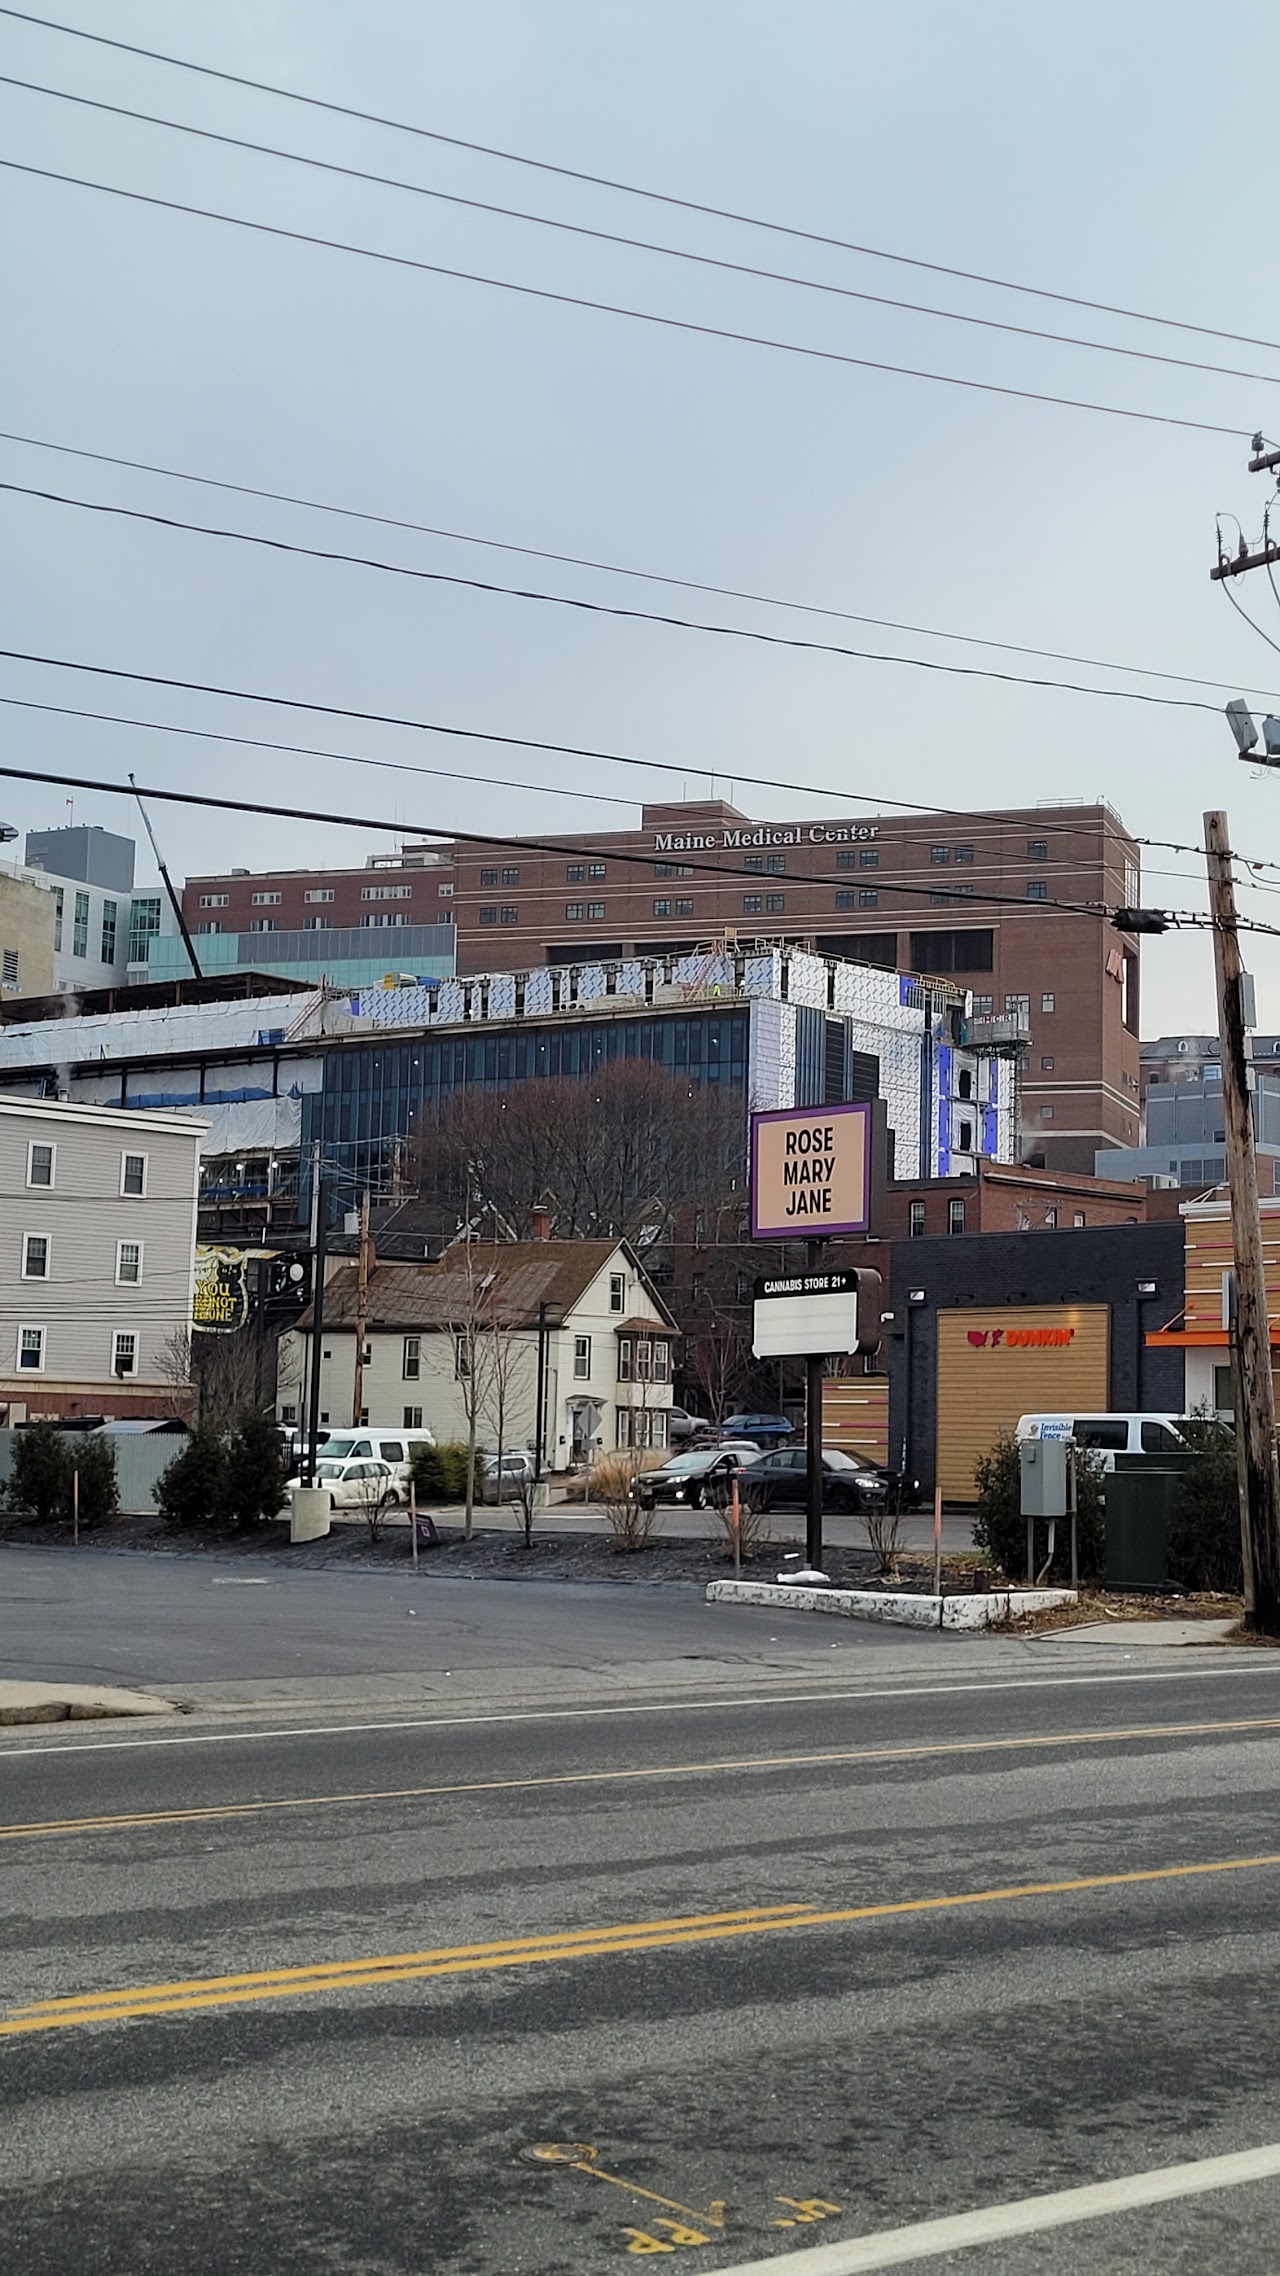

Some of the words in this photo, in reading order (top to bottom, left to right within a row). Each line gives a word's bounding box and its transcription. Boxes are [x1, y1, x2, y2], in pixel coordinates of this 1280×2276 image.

[654, 832, 716, 851] Maine
[722, 827, 802, 848] Medical
[808, 824, 879, 843] Center
[785, 1127, 834, 1156] ROSE
[783, 1157, 836, 1186] MARY
[785, 1188, 832, 1216] JANE
[195, 1280, 231, 1297] YOU
[764, 1279, 802, 1294] CANNABIS
[804, 1276, 829, 1290] STORE
[831, 1275, 847, 1288] 21+
[1005, 1328, 1075, 1347] DUNKIN'
[1041, 1422, 1072, 1431] Invisible
